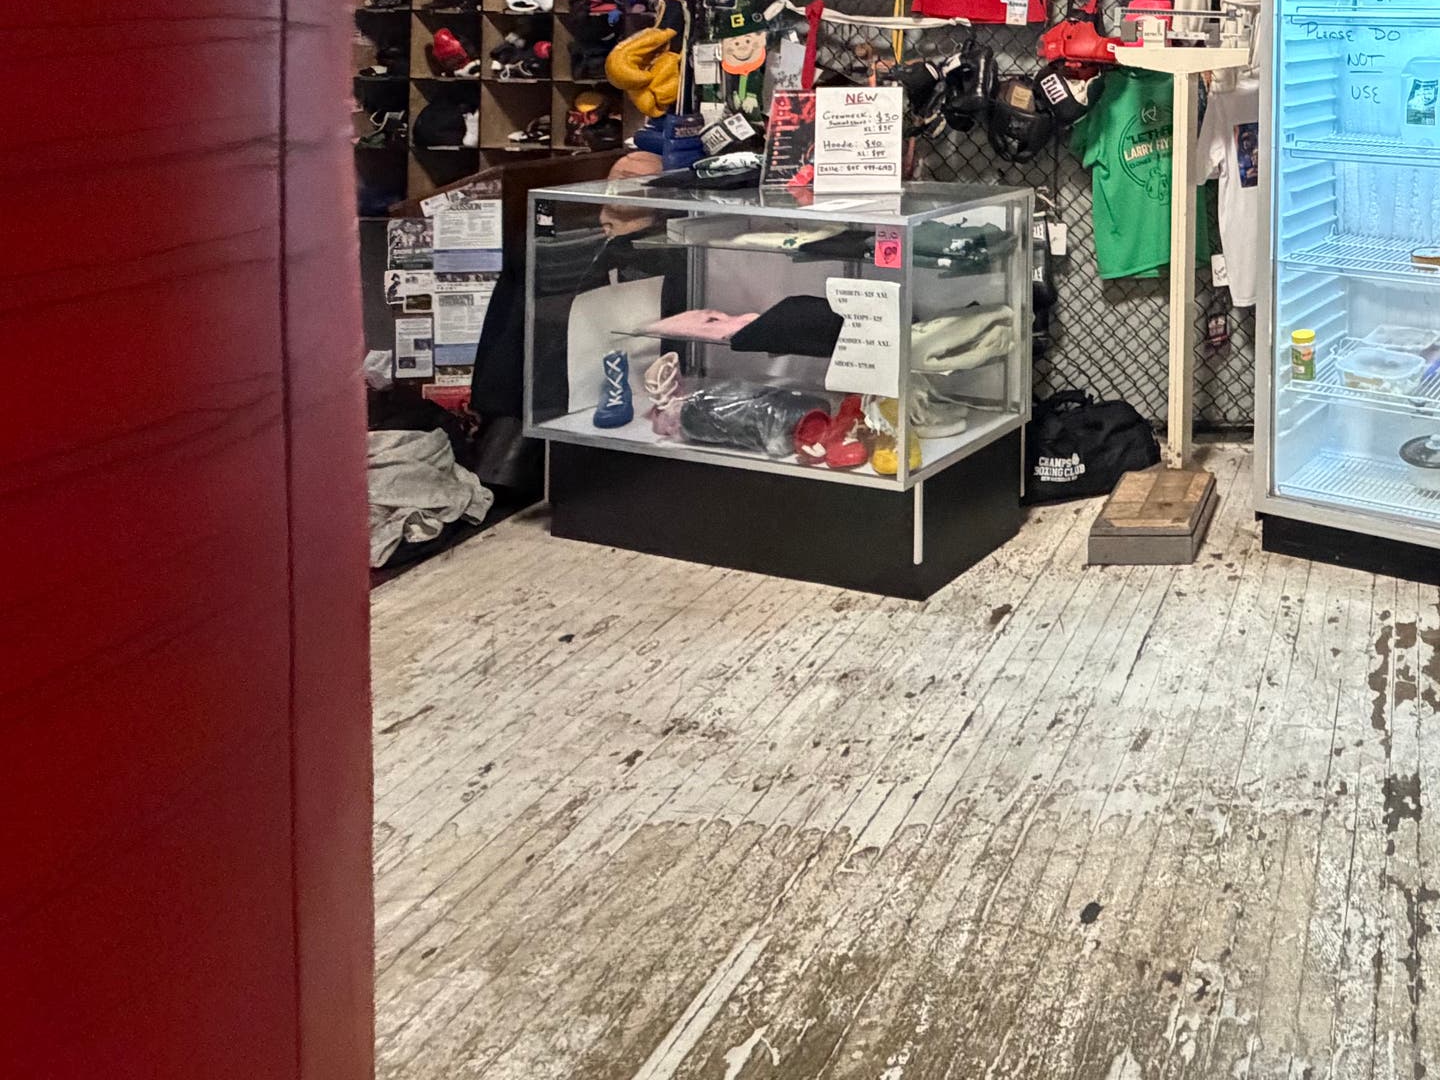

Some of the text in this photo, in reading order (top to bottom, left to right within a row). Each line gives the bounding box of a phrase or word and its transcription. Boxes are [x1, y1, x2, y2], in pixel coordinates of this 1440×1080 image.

[1368, 27, 1401, 41] DO
[1347, 53, 1385, 67] NOT
[845, 92, 878, 104] NEW
[1351, 85, 1381, 104] USE
[1124, 143, 1153, 161] LARRY
[1039, 456, 1072, 468] CHAMPS
[1034, 464, 1086, 477] BOXING CLUB
